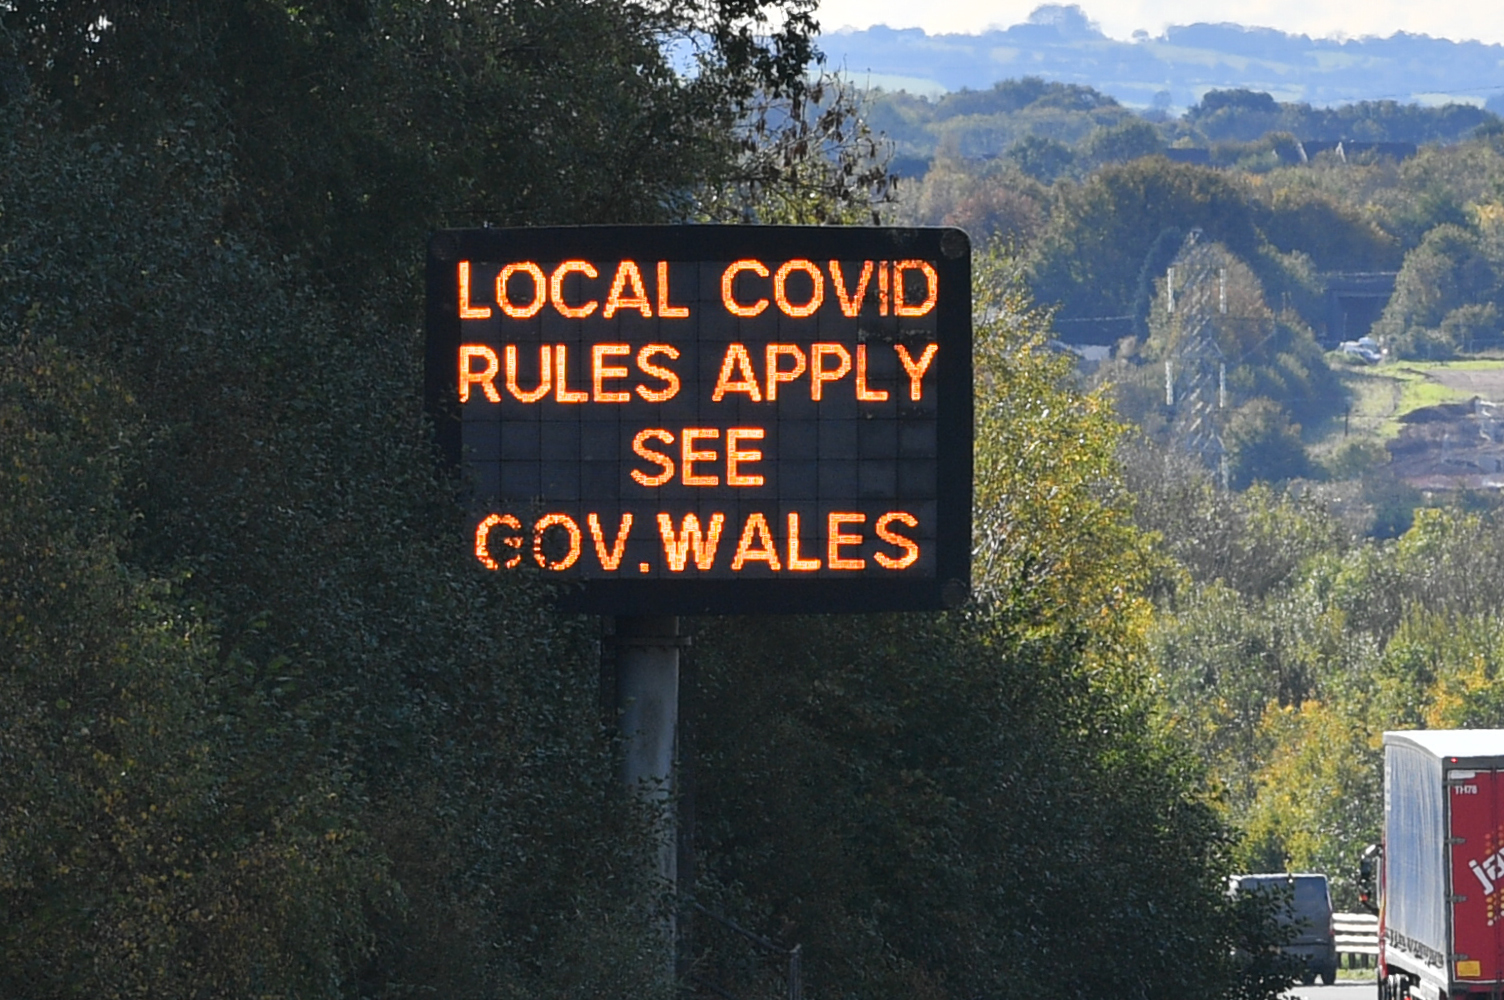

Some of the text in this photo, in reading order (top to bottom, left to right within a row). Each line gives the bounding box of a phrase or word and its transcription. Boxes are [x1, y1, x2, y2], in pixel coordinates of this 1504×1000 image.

[457, 258, 939, 319] LOCAL COVID
[457, 342, 939, 404] RULES APPLY
[630, 427, 766, 487] SEE
[474, 511, 920, 573] GOV.WALES
